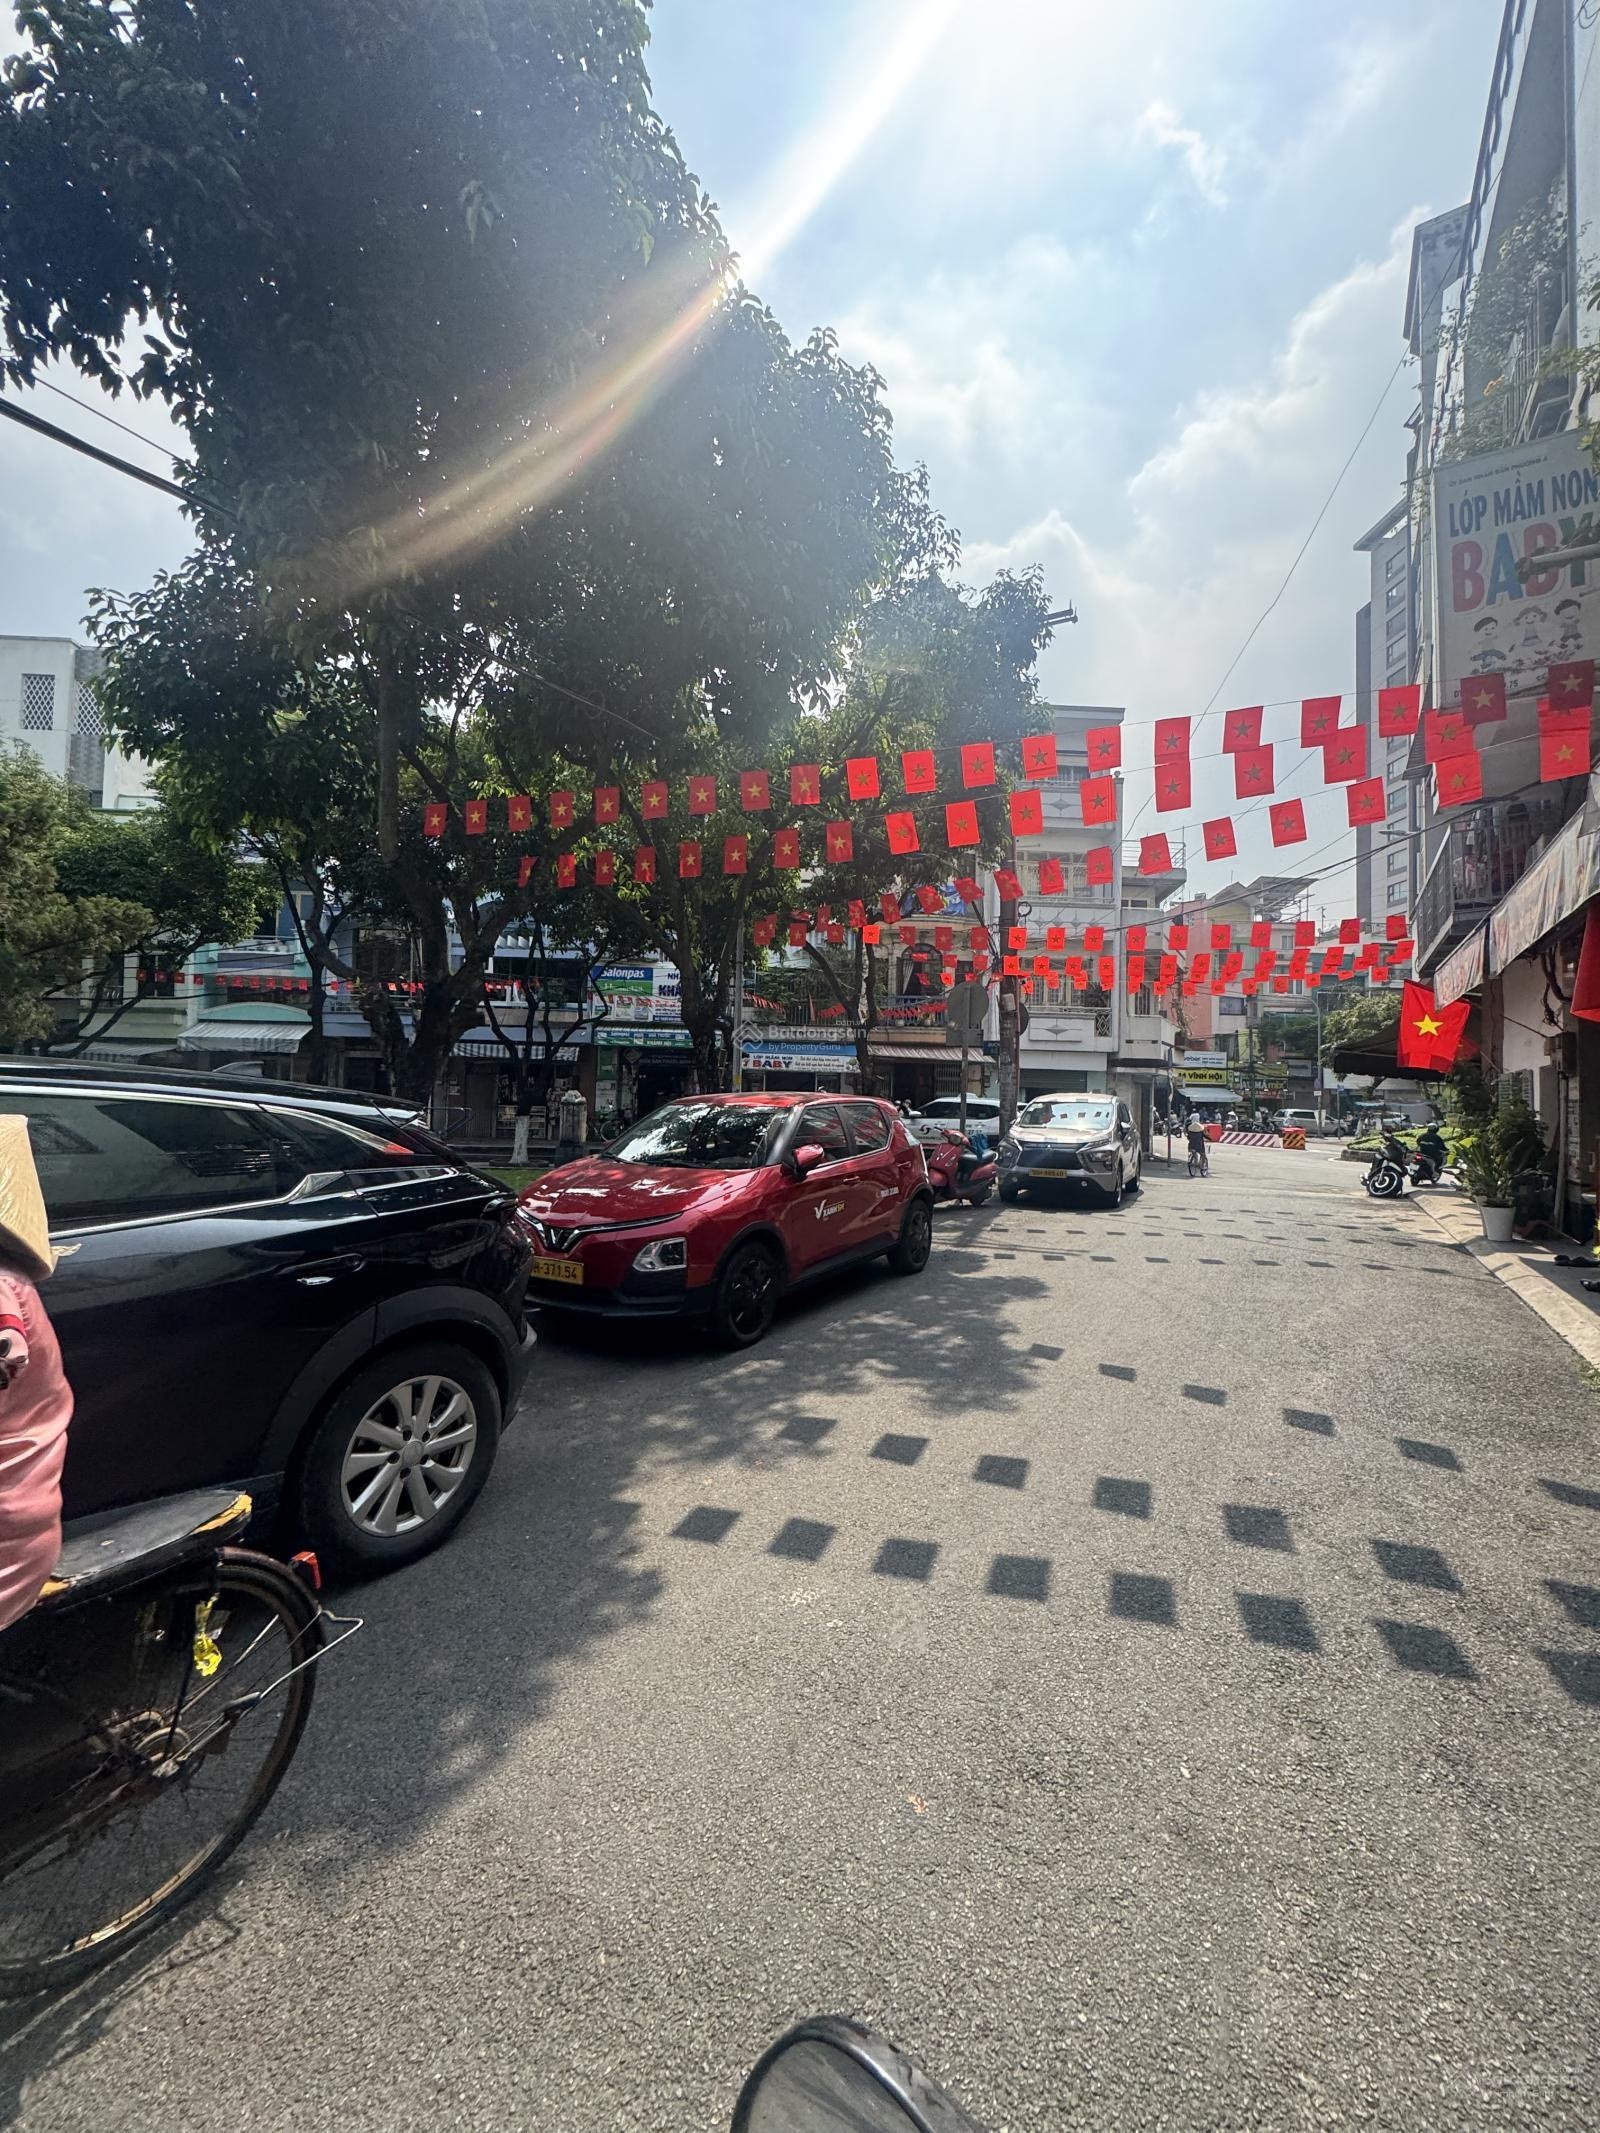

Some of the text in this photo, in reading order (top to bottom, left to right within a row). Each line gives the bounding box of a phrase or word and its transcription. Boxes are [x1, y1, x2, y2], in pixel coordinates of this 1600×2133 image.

[1448, 489, 1487, 538] LỚP
[1493, 471, 1545, 527] MẦM
[1451, 511, 1594, 613] BABY
[601, 967, 645, 980] Salonpas
[752, 1059, 793, 1069] BABY
[1188, 1071, 1207, 1080] VĨNH
[1208, 1072, 1223, 1081] HỘI
[534, 1262, 577, 1279] H-371.54
